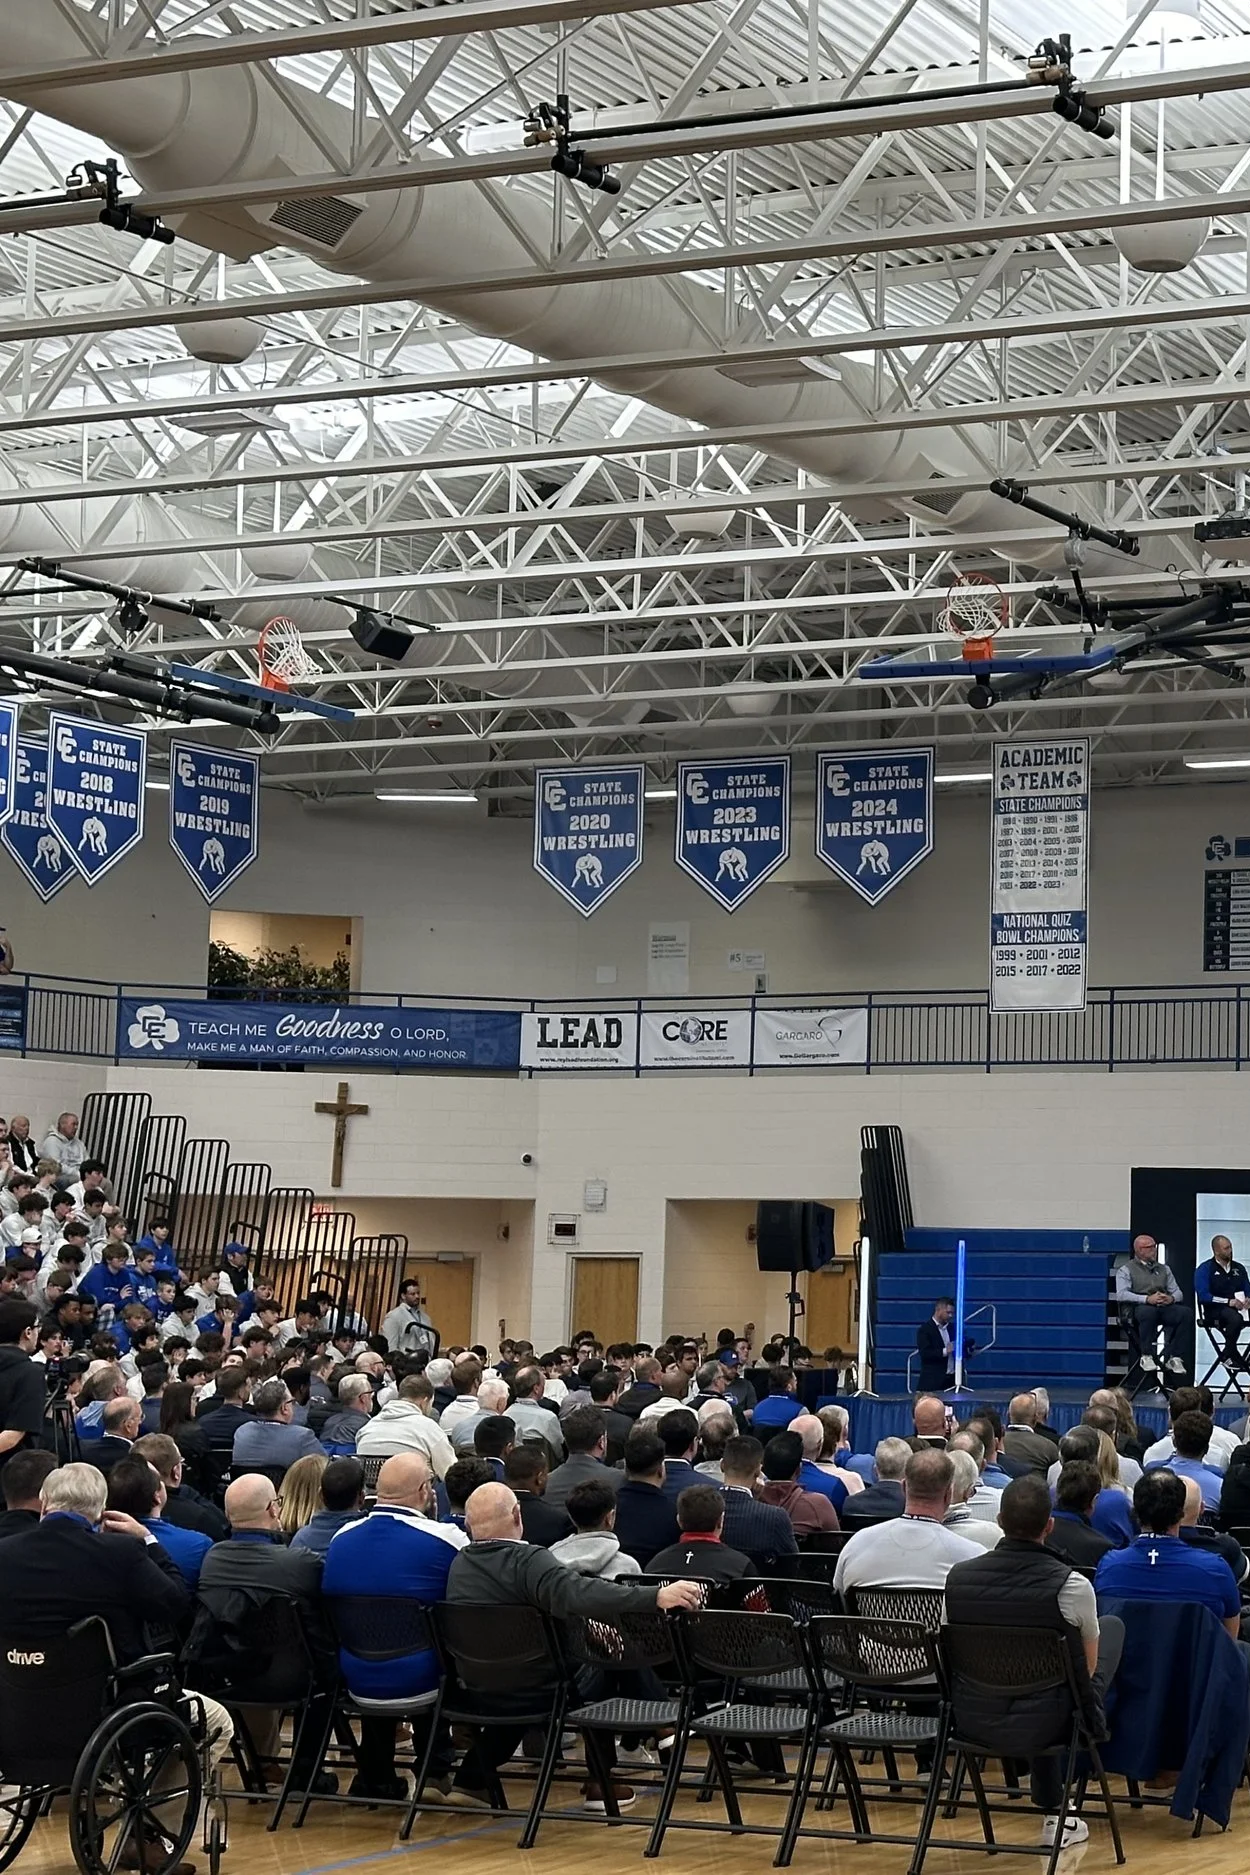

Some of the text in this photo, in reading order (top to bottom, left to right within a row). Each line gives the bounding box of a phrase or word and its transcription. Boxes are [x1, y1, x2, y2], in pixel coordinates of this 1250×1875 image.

[92, 739, 127, 757] STATE
[79, 750, 138, 773] CHAMPIONS
[1000, 747, 1084, 768] ACADEMIC
[210, 763, 241, 780] STATE
[727, 774, 766, 786] STATE
[868, 766, 909, 778] STATE
[80, 771, 114, 793] 2018
[198, 774, 251, 796] CHAMPIONS
[584, 782, 622, 794] STATE
[853, 778, 924, 792] CHAMPIONS
[1018, 771, 1064, 790] TEAM
[569, 794, 635, 808] CHAMPIONS
[712, 786, 780, 800] CHAMPIONS
[54, 788, 136, 818] WRESTLING
[200, 796, 230, 815] 2019
[852, 799, 898, 817] 2024
[1000, 796, 1082, 813] STATE CHAMPIONS
[570, 814, 610, 831] 2020
[712, 807, 757, 825] 2023
[175, 812, 250, 839] WRESTLING
[826, 818, 924, 838] WRESTLING
[543, 834, 636, 852] WRESTLING
[686, 826, 780, 844] WRESTLING
[1003, 912, 1072, 928] NATIONAL QUIZ
[996, 928, 1079, 944] BOWL CHAMPIONS
[996, 948, 1080, 961] 1999 2001 2012
[995, 964, 1081, 977] 2015 2017 2022
[189, 1008, 450, 1042] TEACH ME Goodness O LORD,
[537, 1017, 622, 1048] LEAD
[776, 1031, 823, 1040] GARGARO
[187, 1042, 217, 1051] MAKE
[221, 1043, 237, 1052] ME
[239, 1044, 246, 1052] A
[250, 1044, 274, 1053] MAN
[278, 1045, 292, 1053] OF
[295, 1045, 327, 1056] FAITH,
[403, 1049, 425, 1058] AND
[7, 1649, 45, 1665] drive
